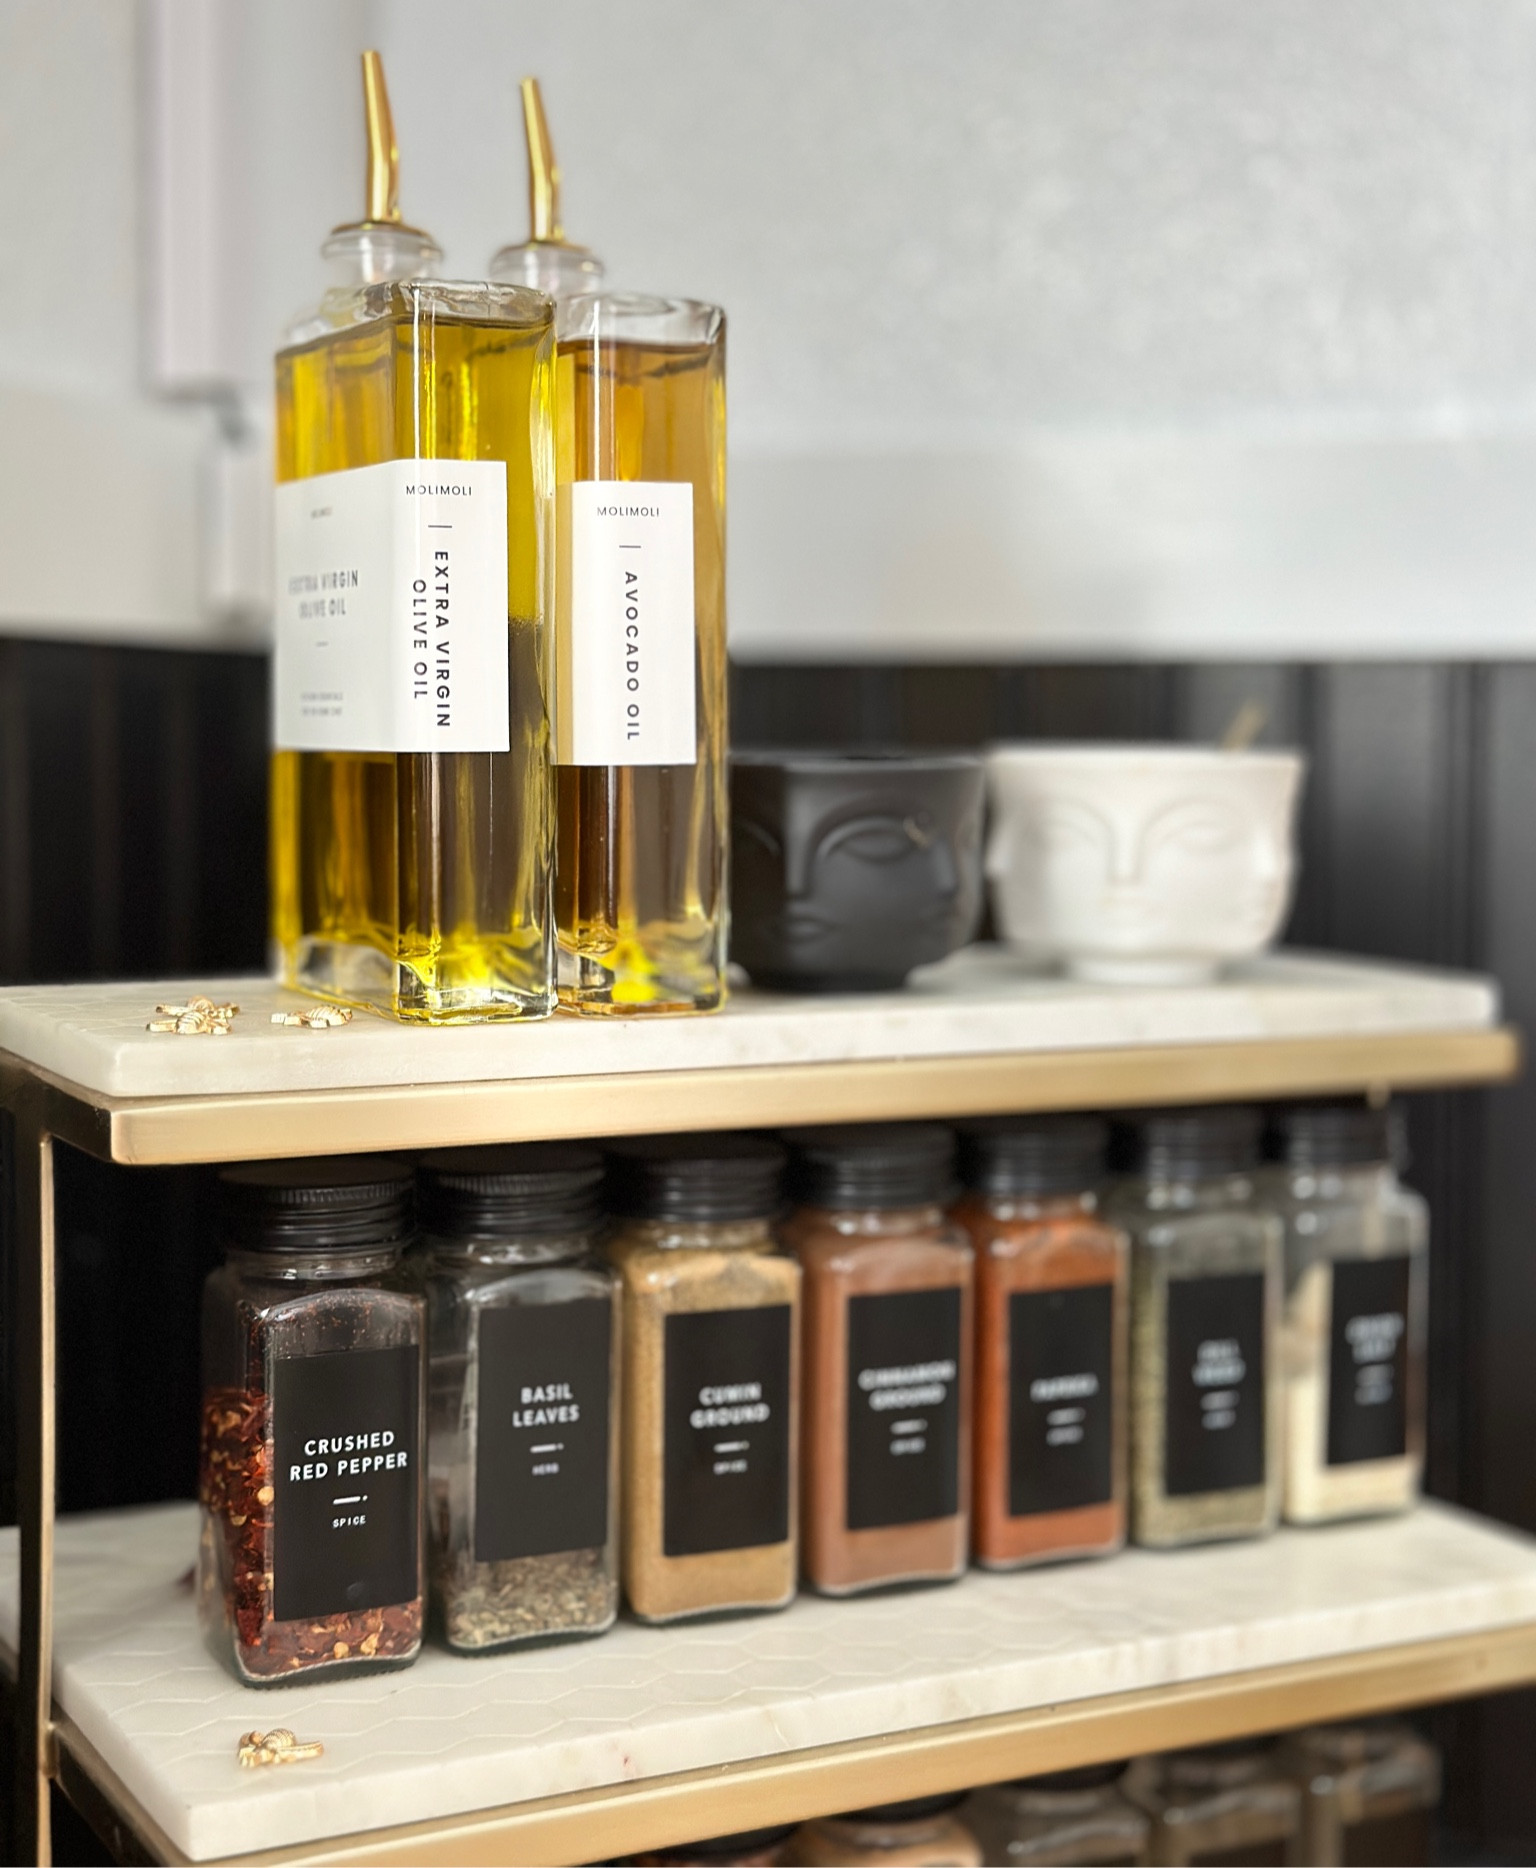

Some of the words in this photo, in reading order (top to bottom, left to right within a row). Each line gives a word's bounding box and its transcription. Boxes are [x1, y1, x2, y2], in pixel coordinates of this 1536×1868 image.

[405, 484, 472, 496] MOLIMOLI
[597, 506, 660, 517] MOLIMOLI
[321, 570, 358, 590] VIRGIN
[434, 551, 450, 629] EXTRA
[412, 579, 428, 649] OLIVE
[625, 571, 640, 692] AVOCADO
[413, 661, 429, 699] OIL
[435, 640, 451, 727] VIRGIN
[626, 703, 640, 741] OIL
[521, 1383, 573, 1404] BASIL
[513, 1404, 579, 1427] LEAVES
[690, 1403, 770, 1429] GROUND
[304, 1430, 395, 1457] CRUSHED
[290, 1462, 328, 1481] RED
[337, 1451, 408, 1477] PEPPER
[332, 1515, 366, 1528] SPICE
